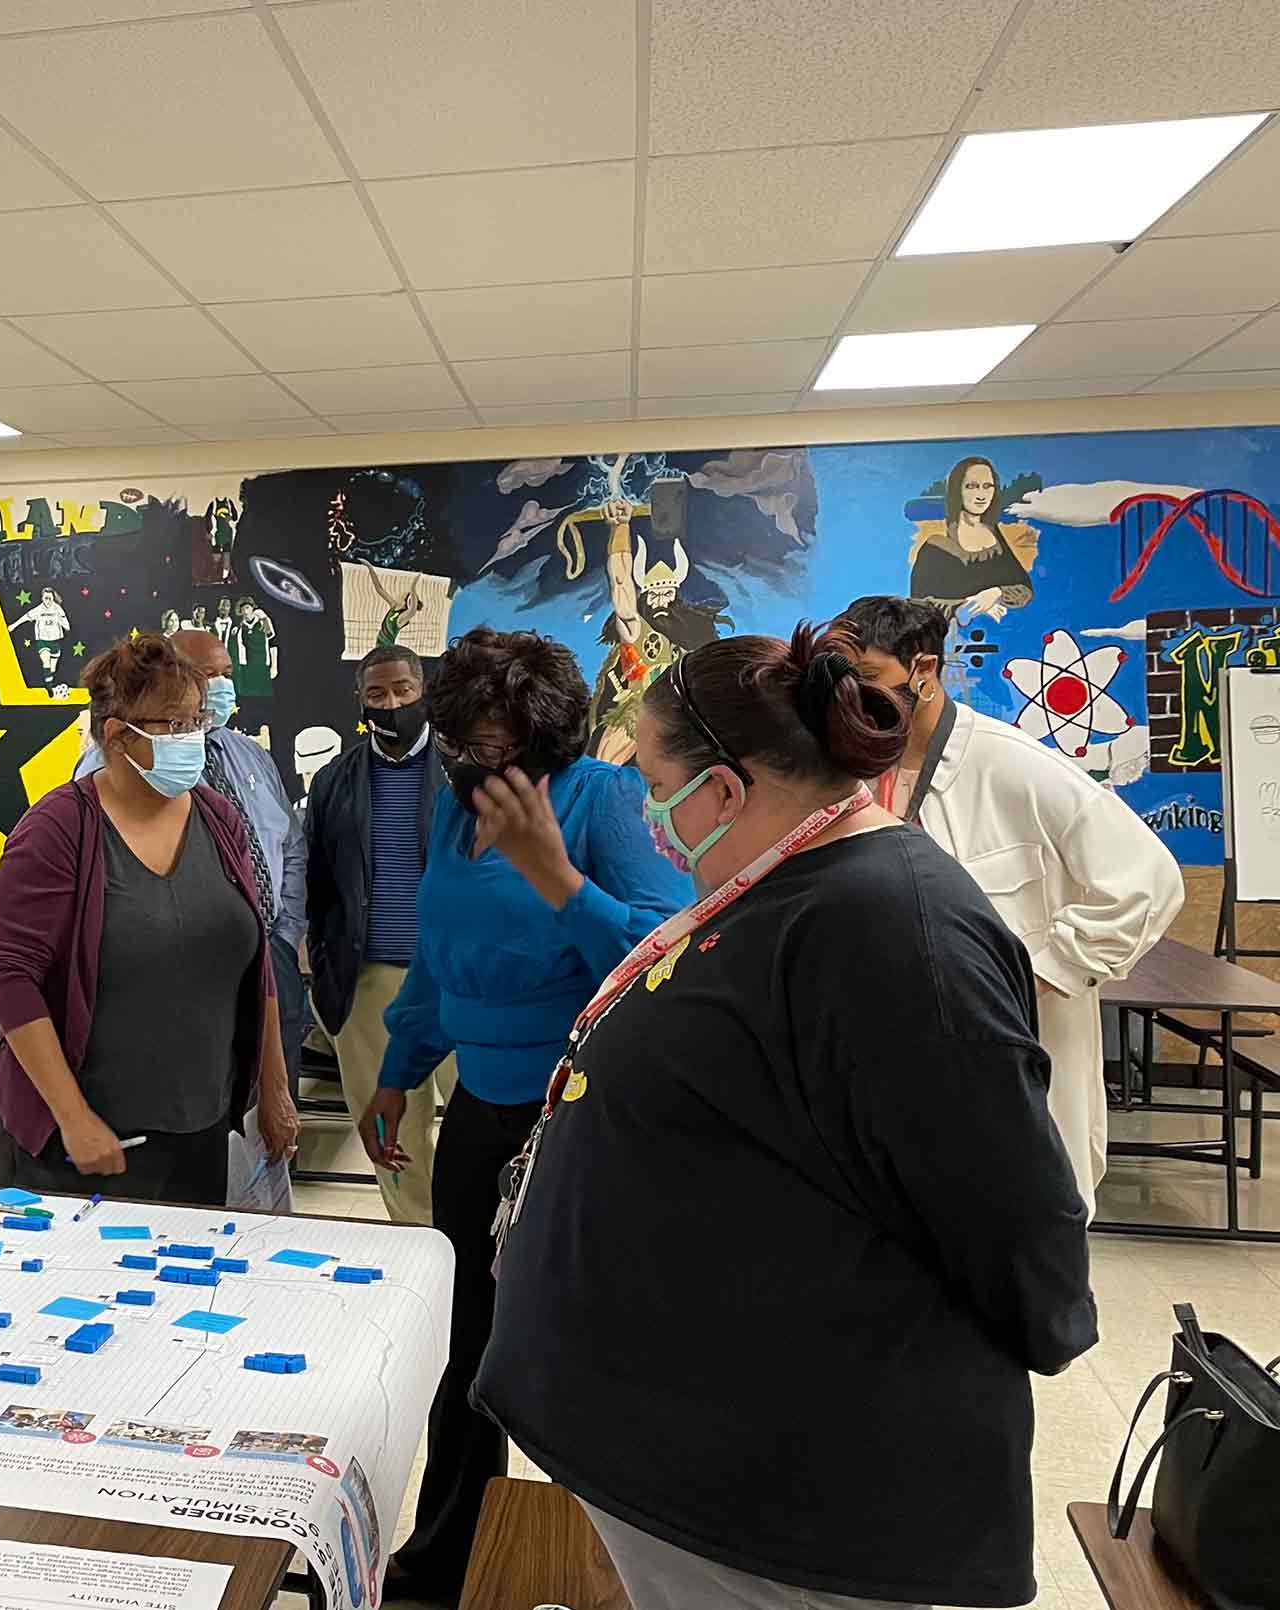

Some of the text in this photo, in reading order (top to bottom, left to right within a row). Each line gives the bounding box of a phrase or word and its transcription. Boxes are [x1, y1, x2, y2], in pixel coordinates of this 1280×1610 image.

[97, 1487, 258, 1513] SIMULATION
[168, 1505, 312, 1537] CONSIDER
[66, 1592, 176, 1610] SITE VIABILITY
